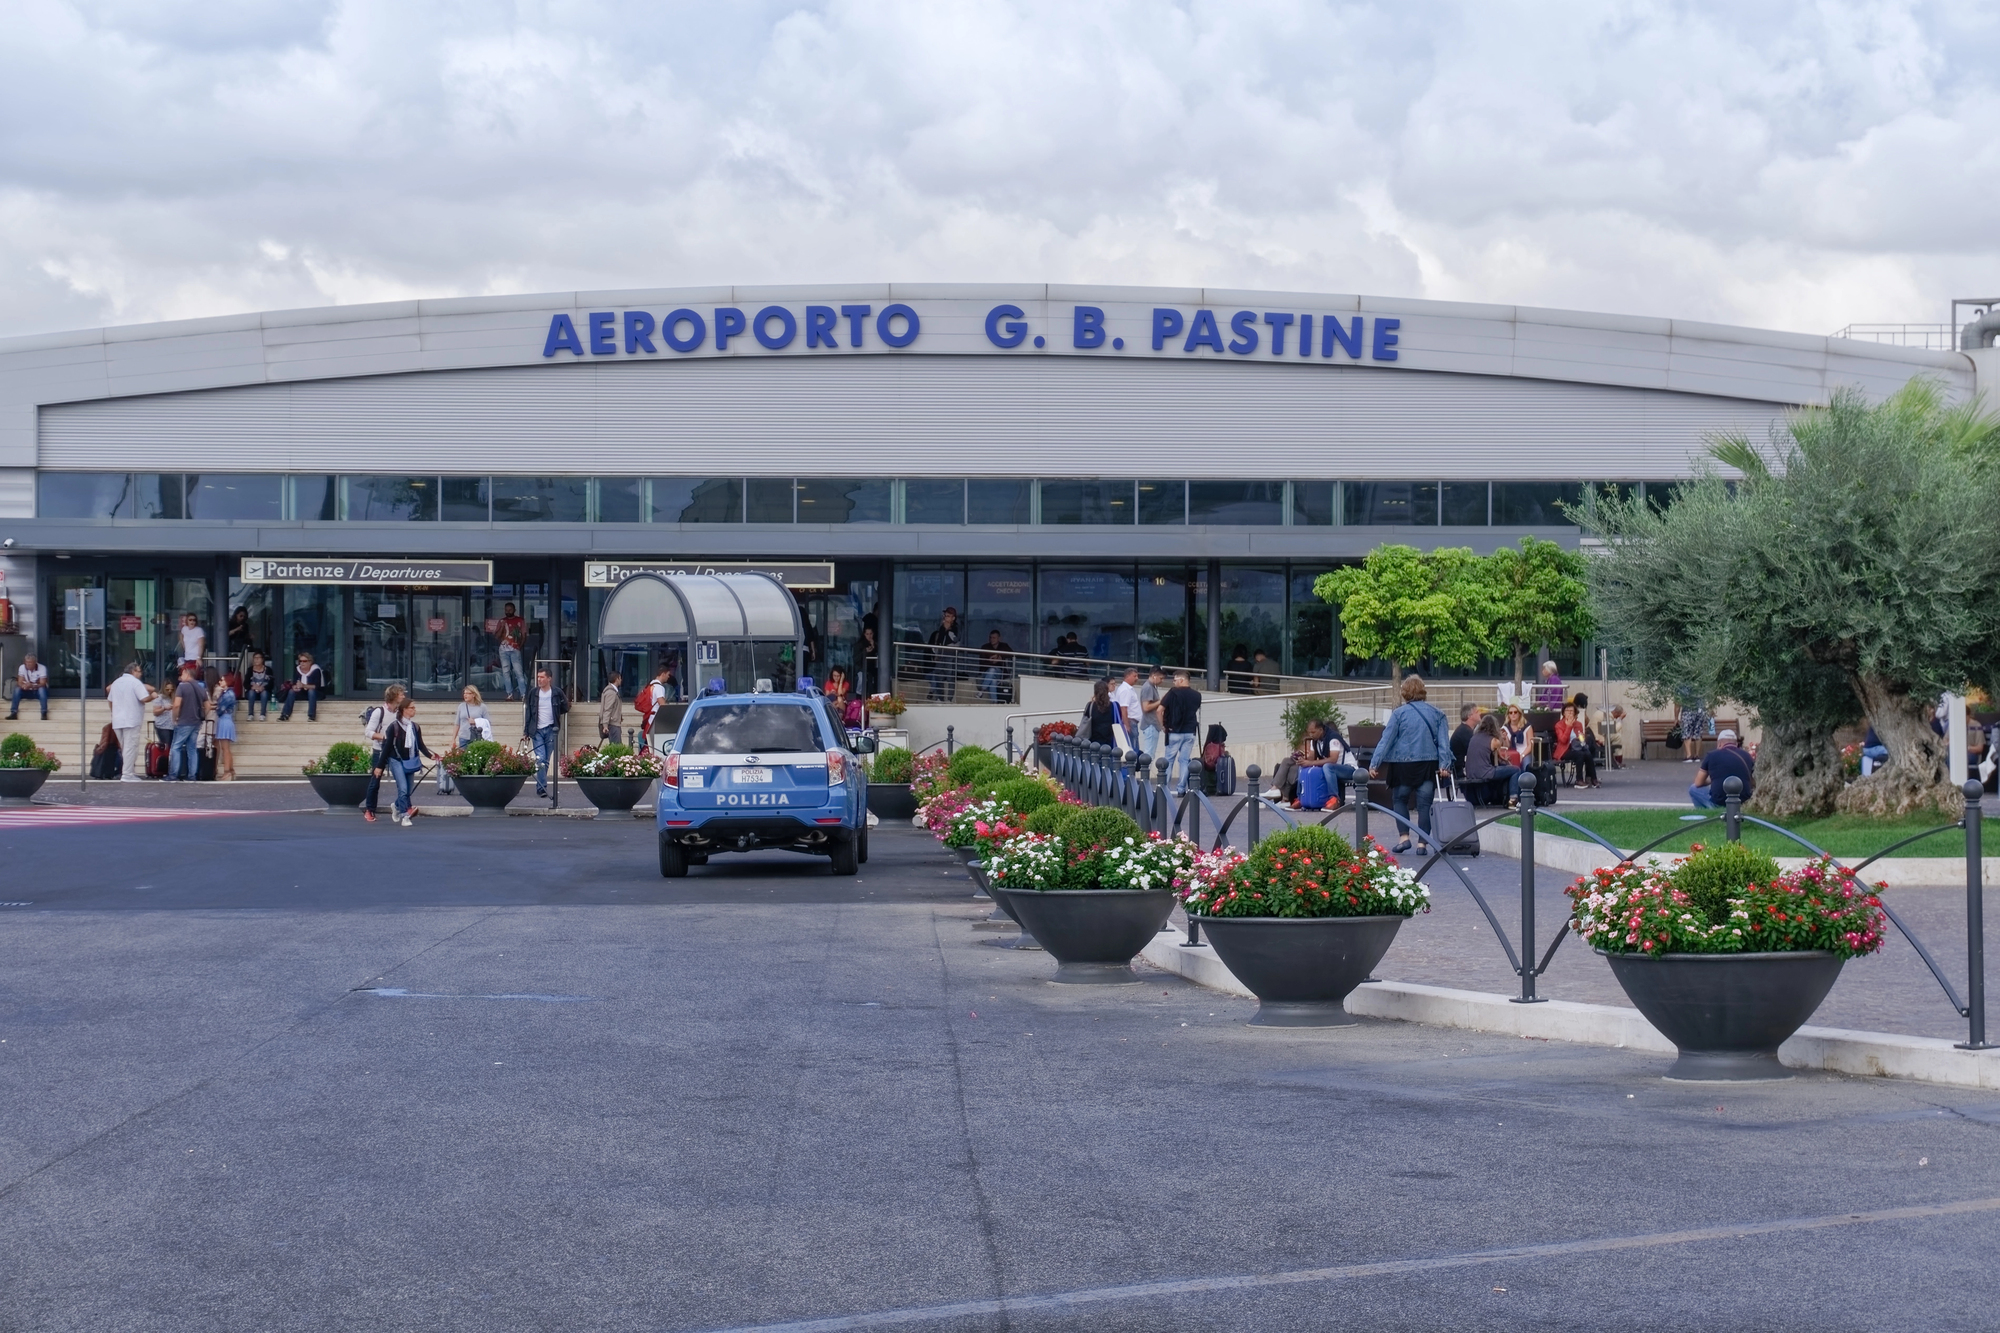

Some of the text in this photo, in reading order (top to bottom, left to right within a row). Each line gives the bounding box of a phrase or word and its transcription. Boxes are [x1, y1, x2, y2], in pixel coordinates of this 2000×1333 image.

[543, 303, 1401, 361] AEROPORTO G. B. PASTINE
[267, 562, 344, 578] Partenze
[360, 565, 442, 580] Departures
[610, 565, 687, 580] Parnze
[1155, 577, 1165, 585] 10
[716, 793, 790, 805] POLIZIA
